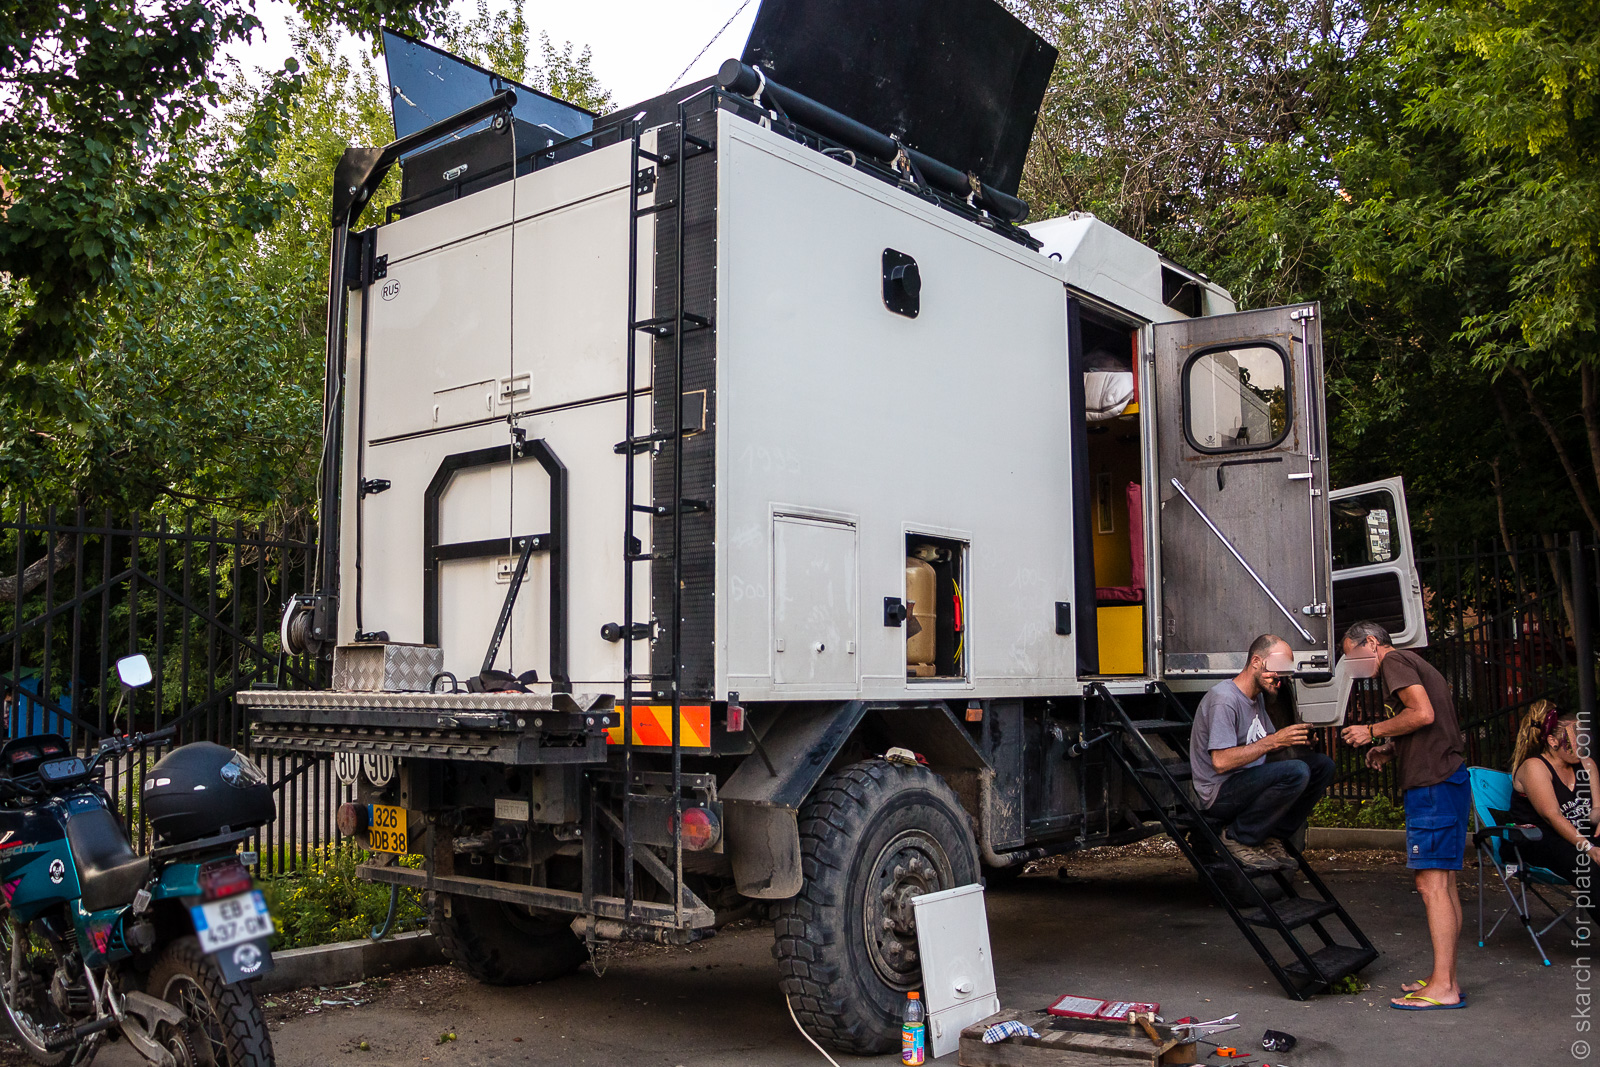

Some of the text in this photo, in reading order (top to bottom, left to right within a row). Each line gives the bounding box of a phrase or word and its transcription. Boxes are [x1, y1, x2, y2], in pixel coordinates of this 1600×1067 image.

[383, 282, 399, 297] RUS
[339, 752, 355, 780] 80
[368, 754, 390, 781] 90
[375, 807, 398, 828] 326
[390, 832, 406, 852] 38
